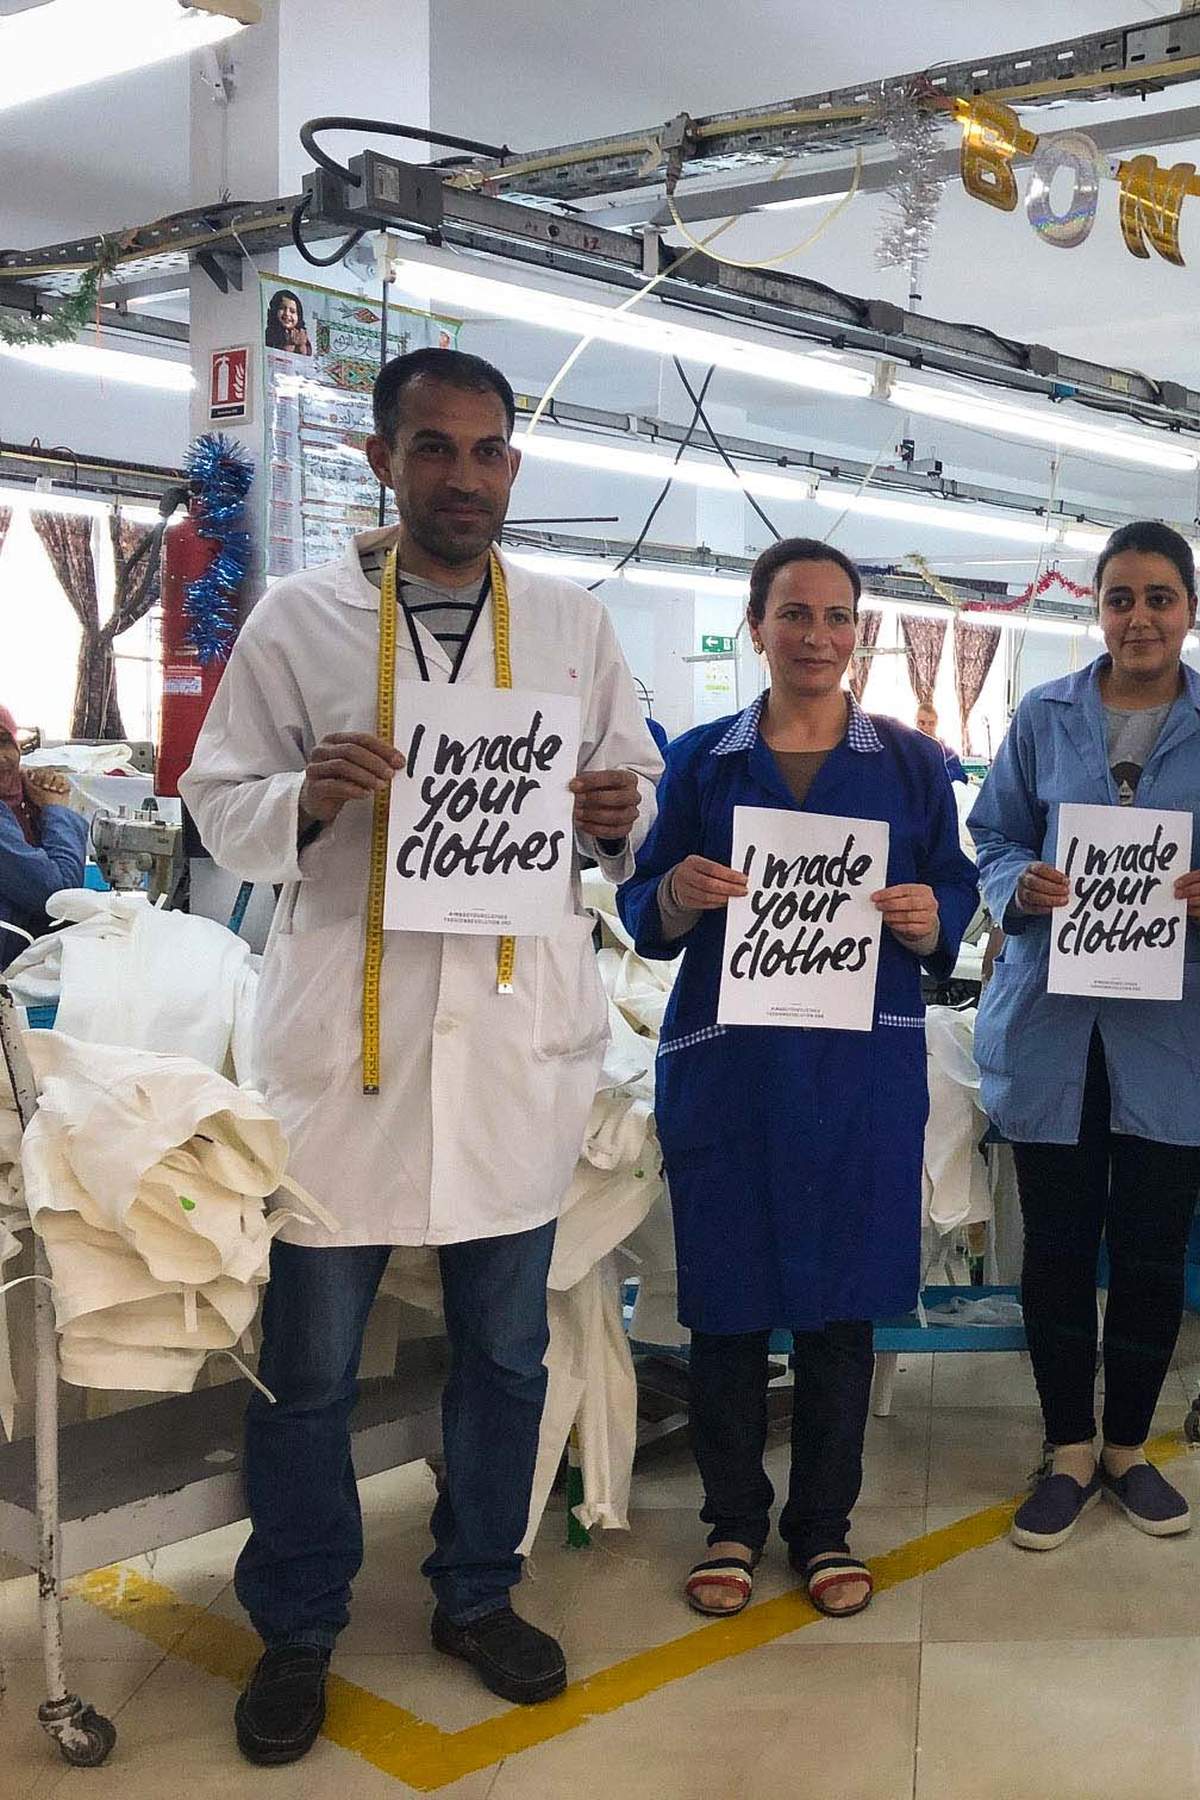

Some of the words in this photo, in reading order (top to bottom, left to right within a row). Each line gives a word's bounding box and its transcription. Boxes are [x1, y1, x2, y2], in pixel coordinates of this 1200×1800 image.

[407, 723, 426, 779] I
[433, 710, 563, 775] made
[413, 775, 542, 833] your
[396, 818, 565, 881] clothes
[742, 844, 756, 883] I
[762, 834, 873, 888] made
[1065, 836, 1080, 880] I
[1084, 824, 1179, 876] made
[744, 887, 852, 939] your
[1069, 874, 1162, 920] your
[729, 927, 873, 981] clothes
[1057, 909, 1181, 956] clothes
